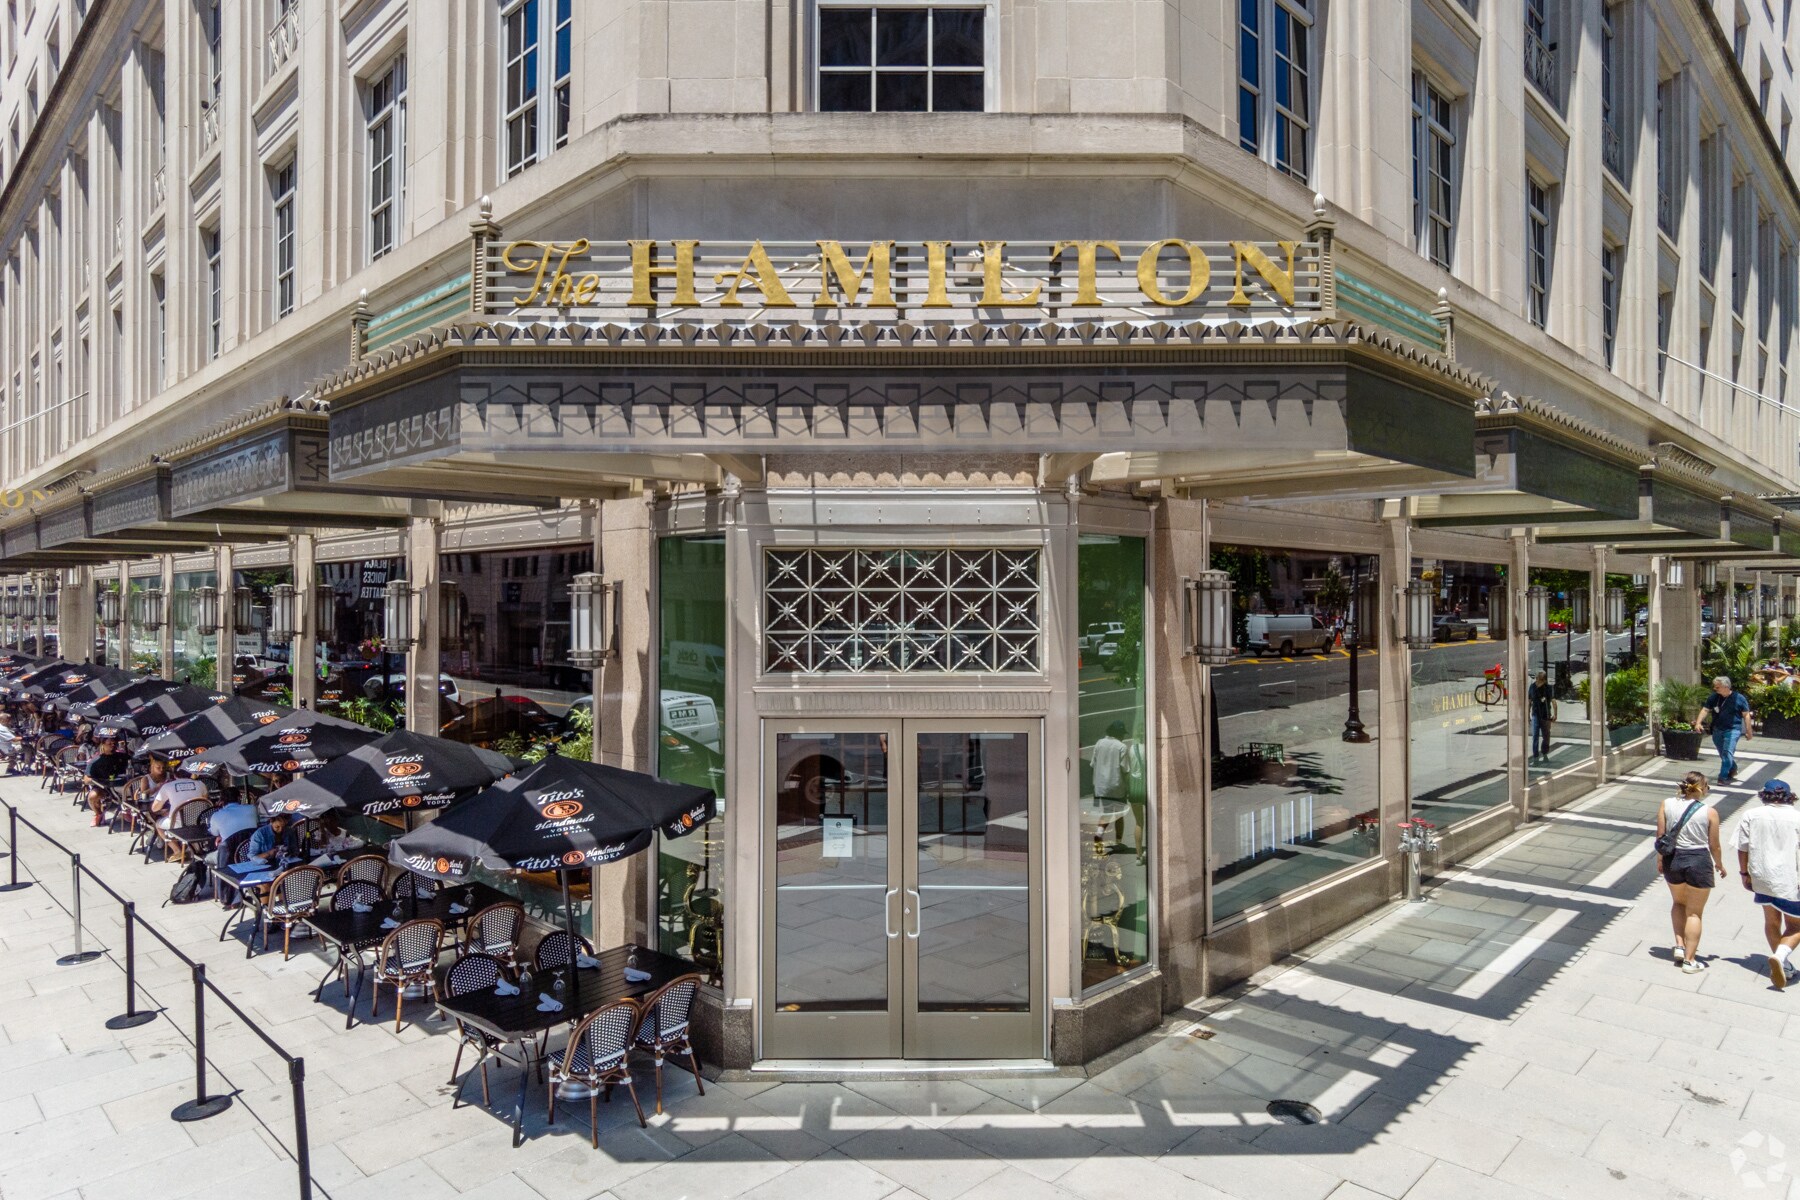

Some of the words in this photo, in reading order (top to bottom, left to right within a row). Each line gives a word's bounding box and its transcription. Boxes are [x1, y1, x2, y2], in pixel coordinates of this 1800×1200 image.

[502, 237, 600, 305] The
[627, 238, 1302, 307] HAMILTON
[382, 771, 431, 785] Handmade
[422, 791, 456, 801] Handmade
[534, 813, 596, 832] Handmade
[550, 824, 582, 834] VODKA
[586, 842, 626, 858] Handmade
[591, 851, 622, 862] VODKA
